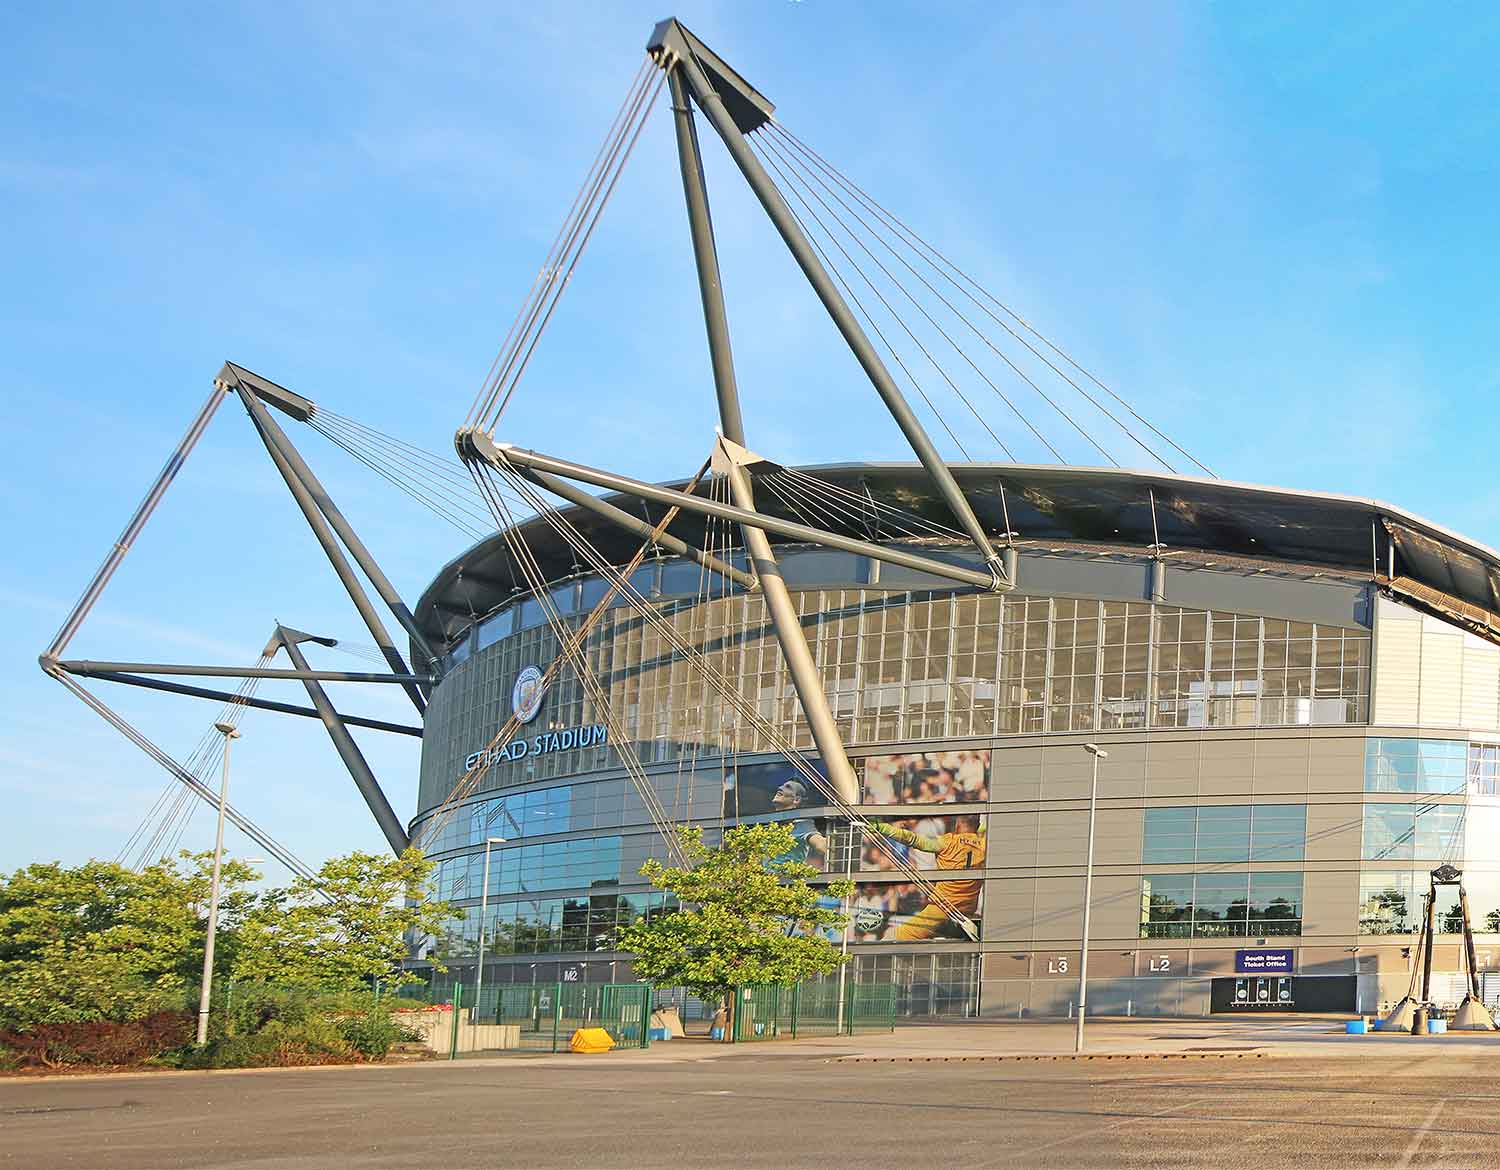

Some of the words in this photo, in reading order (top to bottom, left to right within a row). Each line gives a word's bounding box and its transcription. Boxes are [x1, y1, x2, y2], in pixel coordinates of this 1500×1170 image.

[465, 740, 528, 771] ETIHAD
[534, 725, 608, 755] STADIUM
[1048, 960, 1068, 973] L3
[1150, 959, 1170, 972] L2
[1476, 954, 1491, 967] L1
[564, 969, 578, 982] M2
